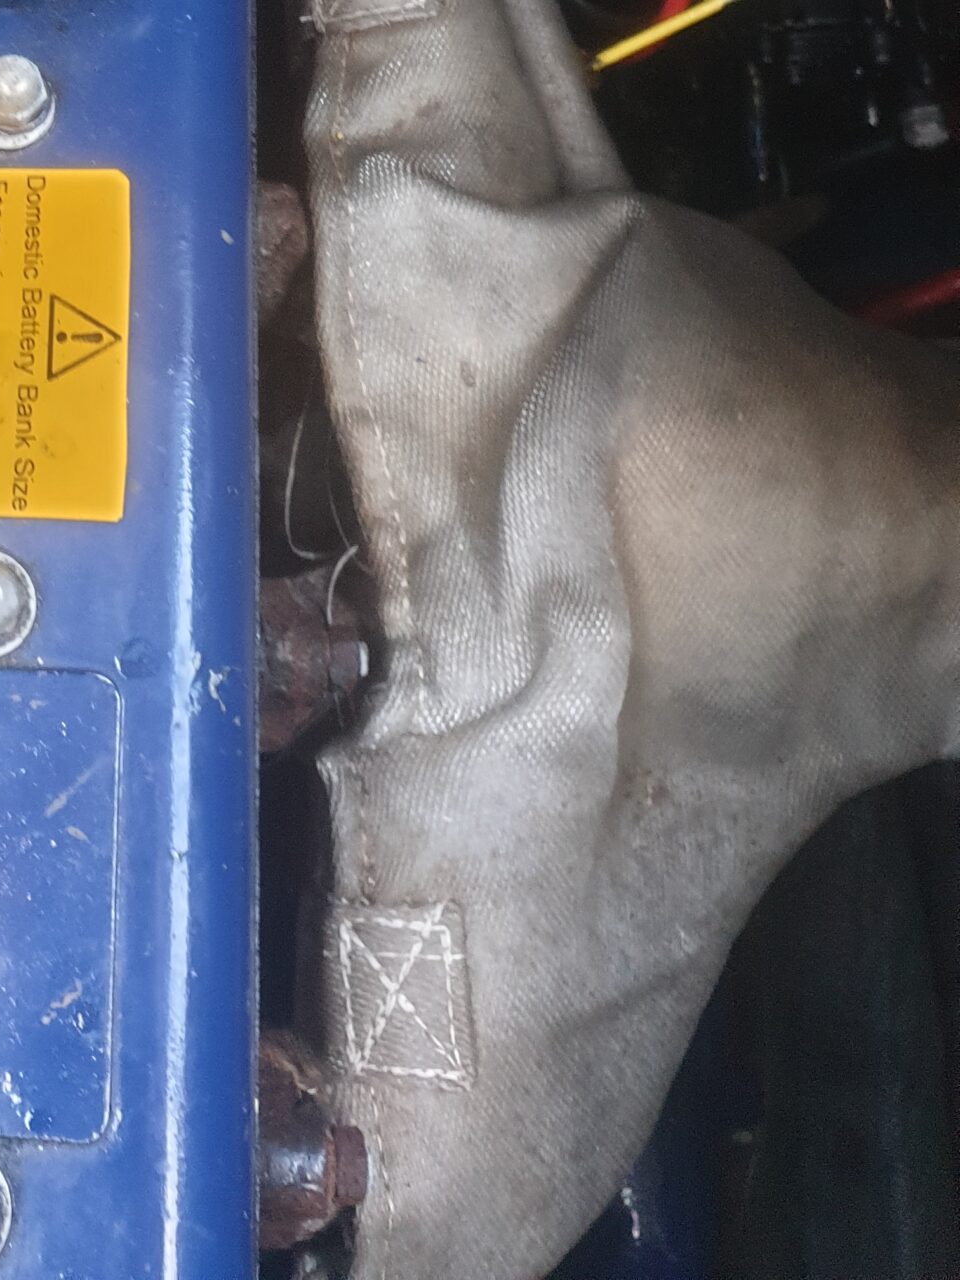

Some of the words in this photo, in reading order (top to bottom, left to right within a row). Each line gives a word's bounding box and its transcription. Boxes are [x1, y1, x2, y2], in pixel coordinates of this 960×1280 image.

[21, 176, 46, 279] Domestic
[14, 288, 43, 374] Battery
[14, 384, 39, 448] Bank
[11, 457, 36, 511] Size
